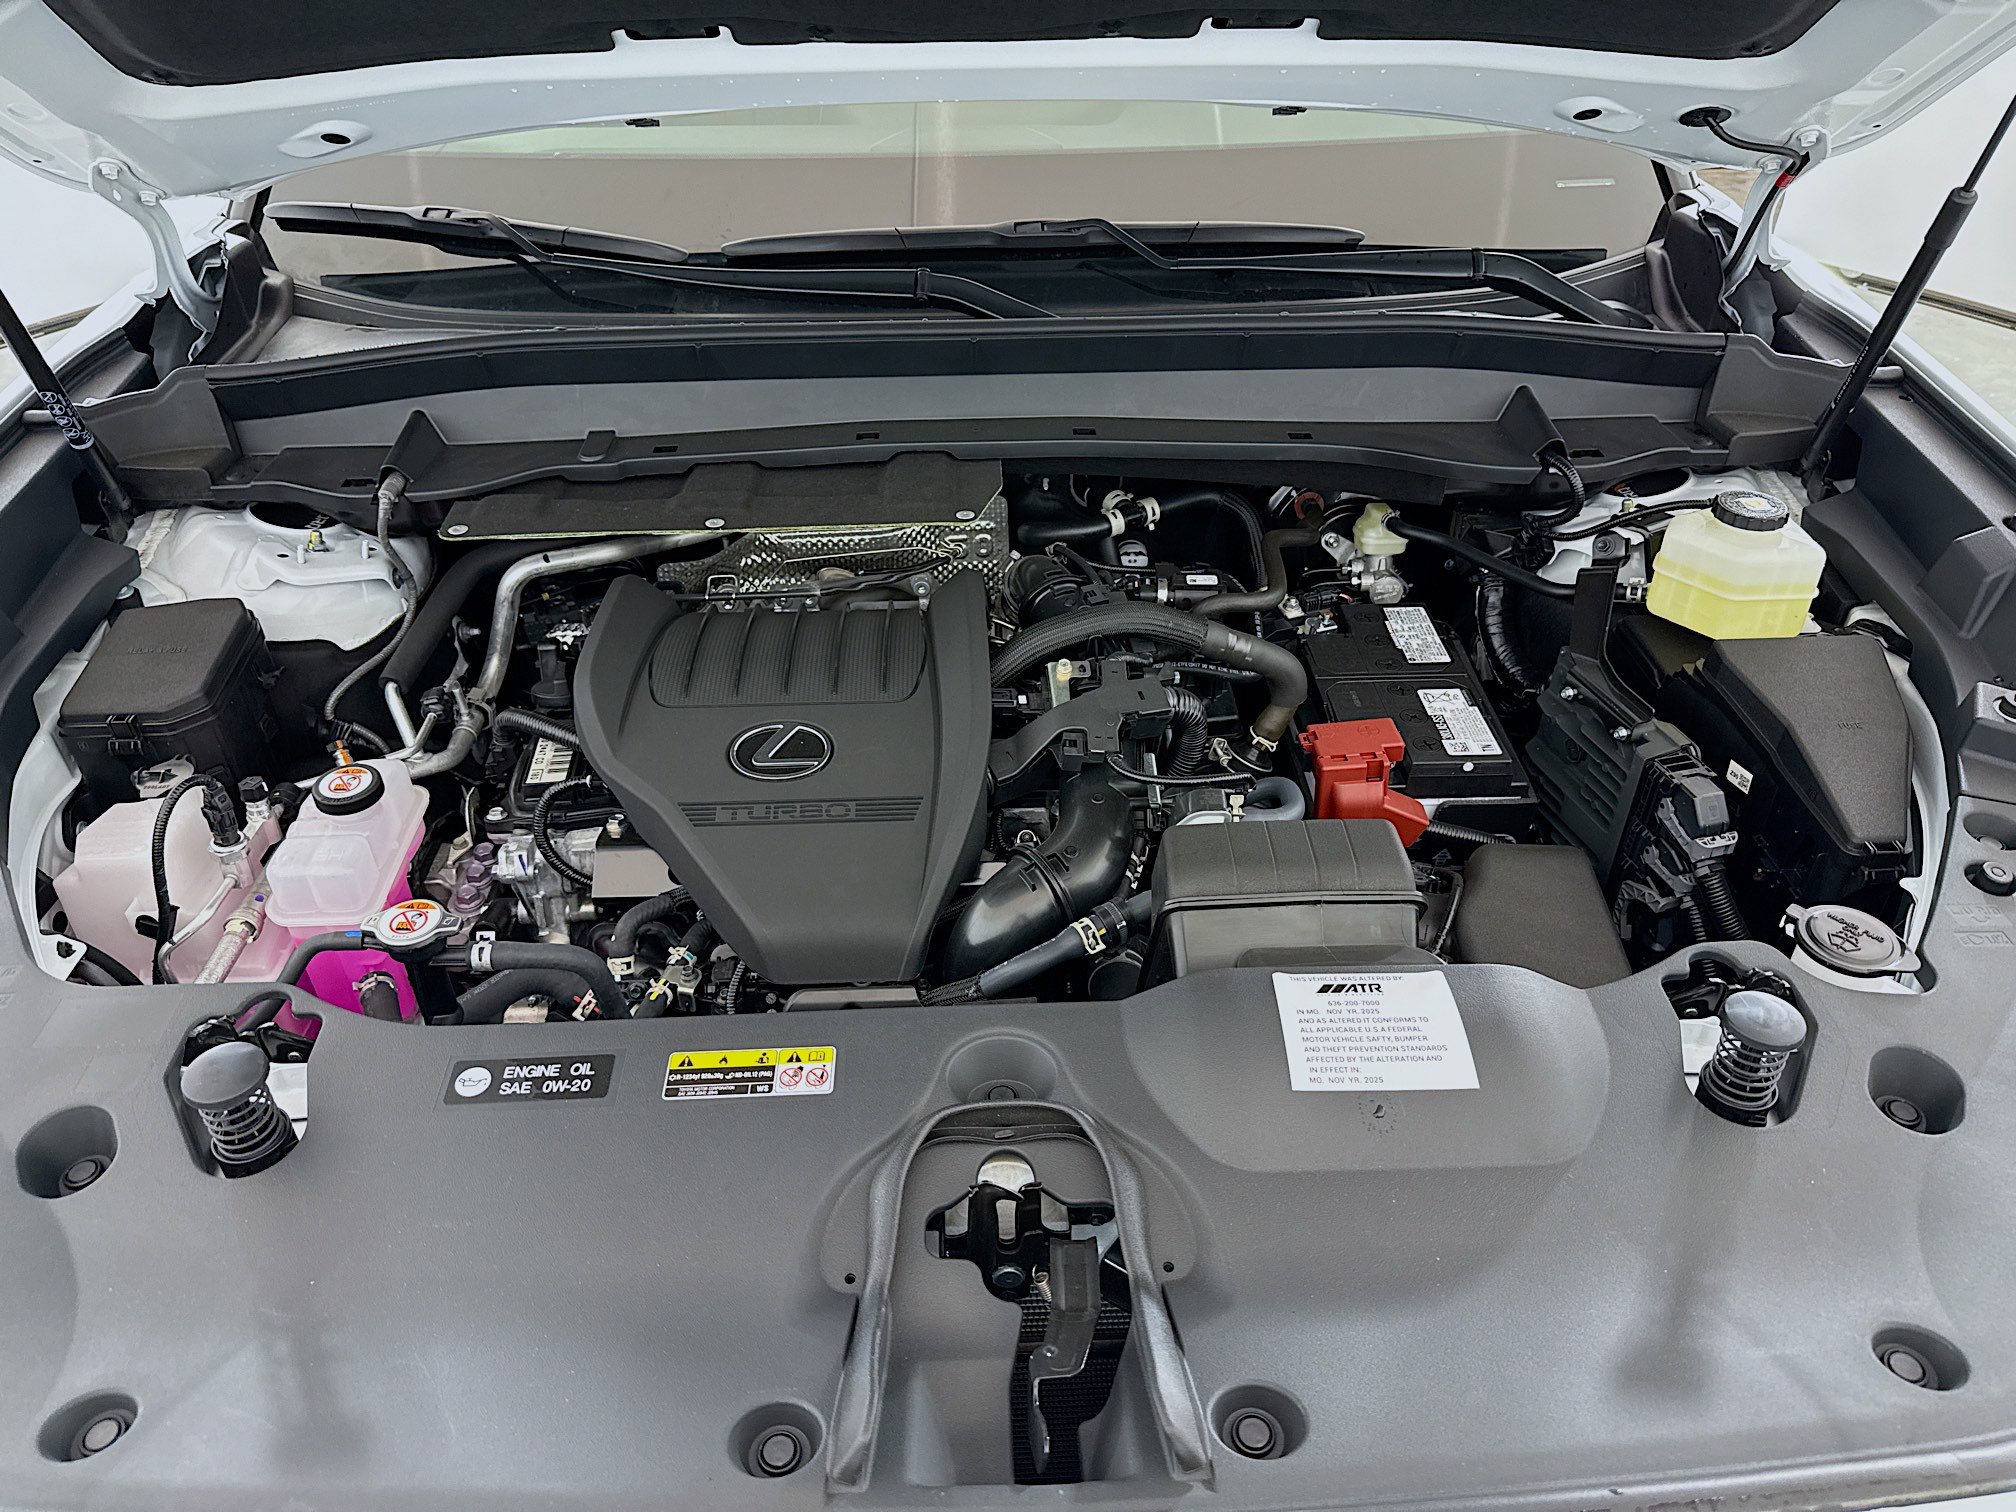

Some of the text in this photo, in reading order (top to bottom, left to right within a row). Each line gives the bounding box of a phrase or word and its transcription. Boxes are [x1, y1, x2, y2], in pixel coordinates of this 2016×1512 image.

[720, 801, 852, 821] TURBO
[1344, 983, 1383, 993] ATR
[503, 1063, 596, 1079] ENGINE OIL
[499, 1079, 592, 1095] SAE 0W-20
